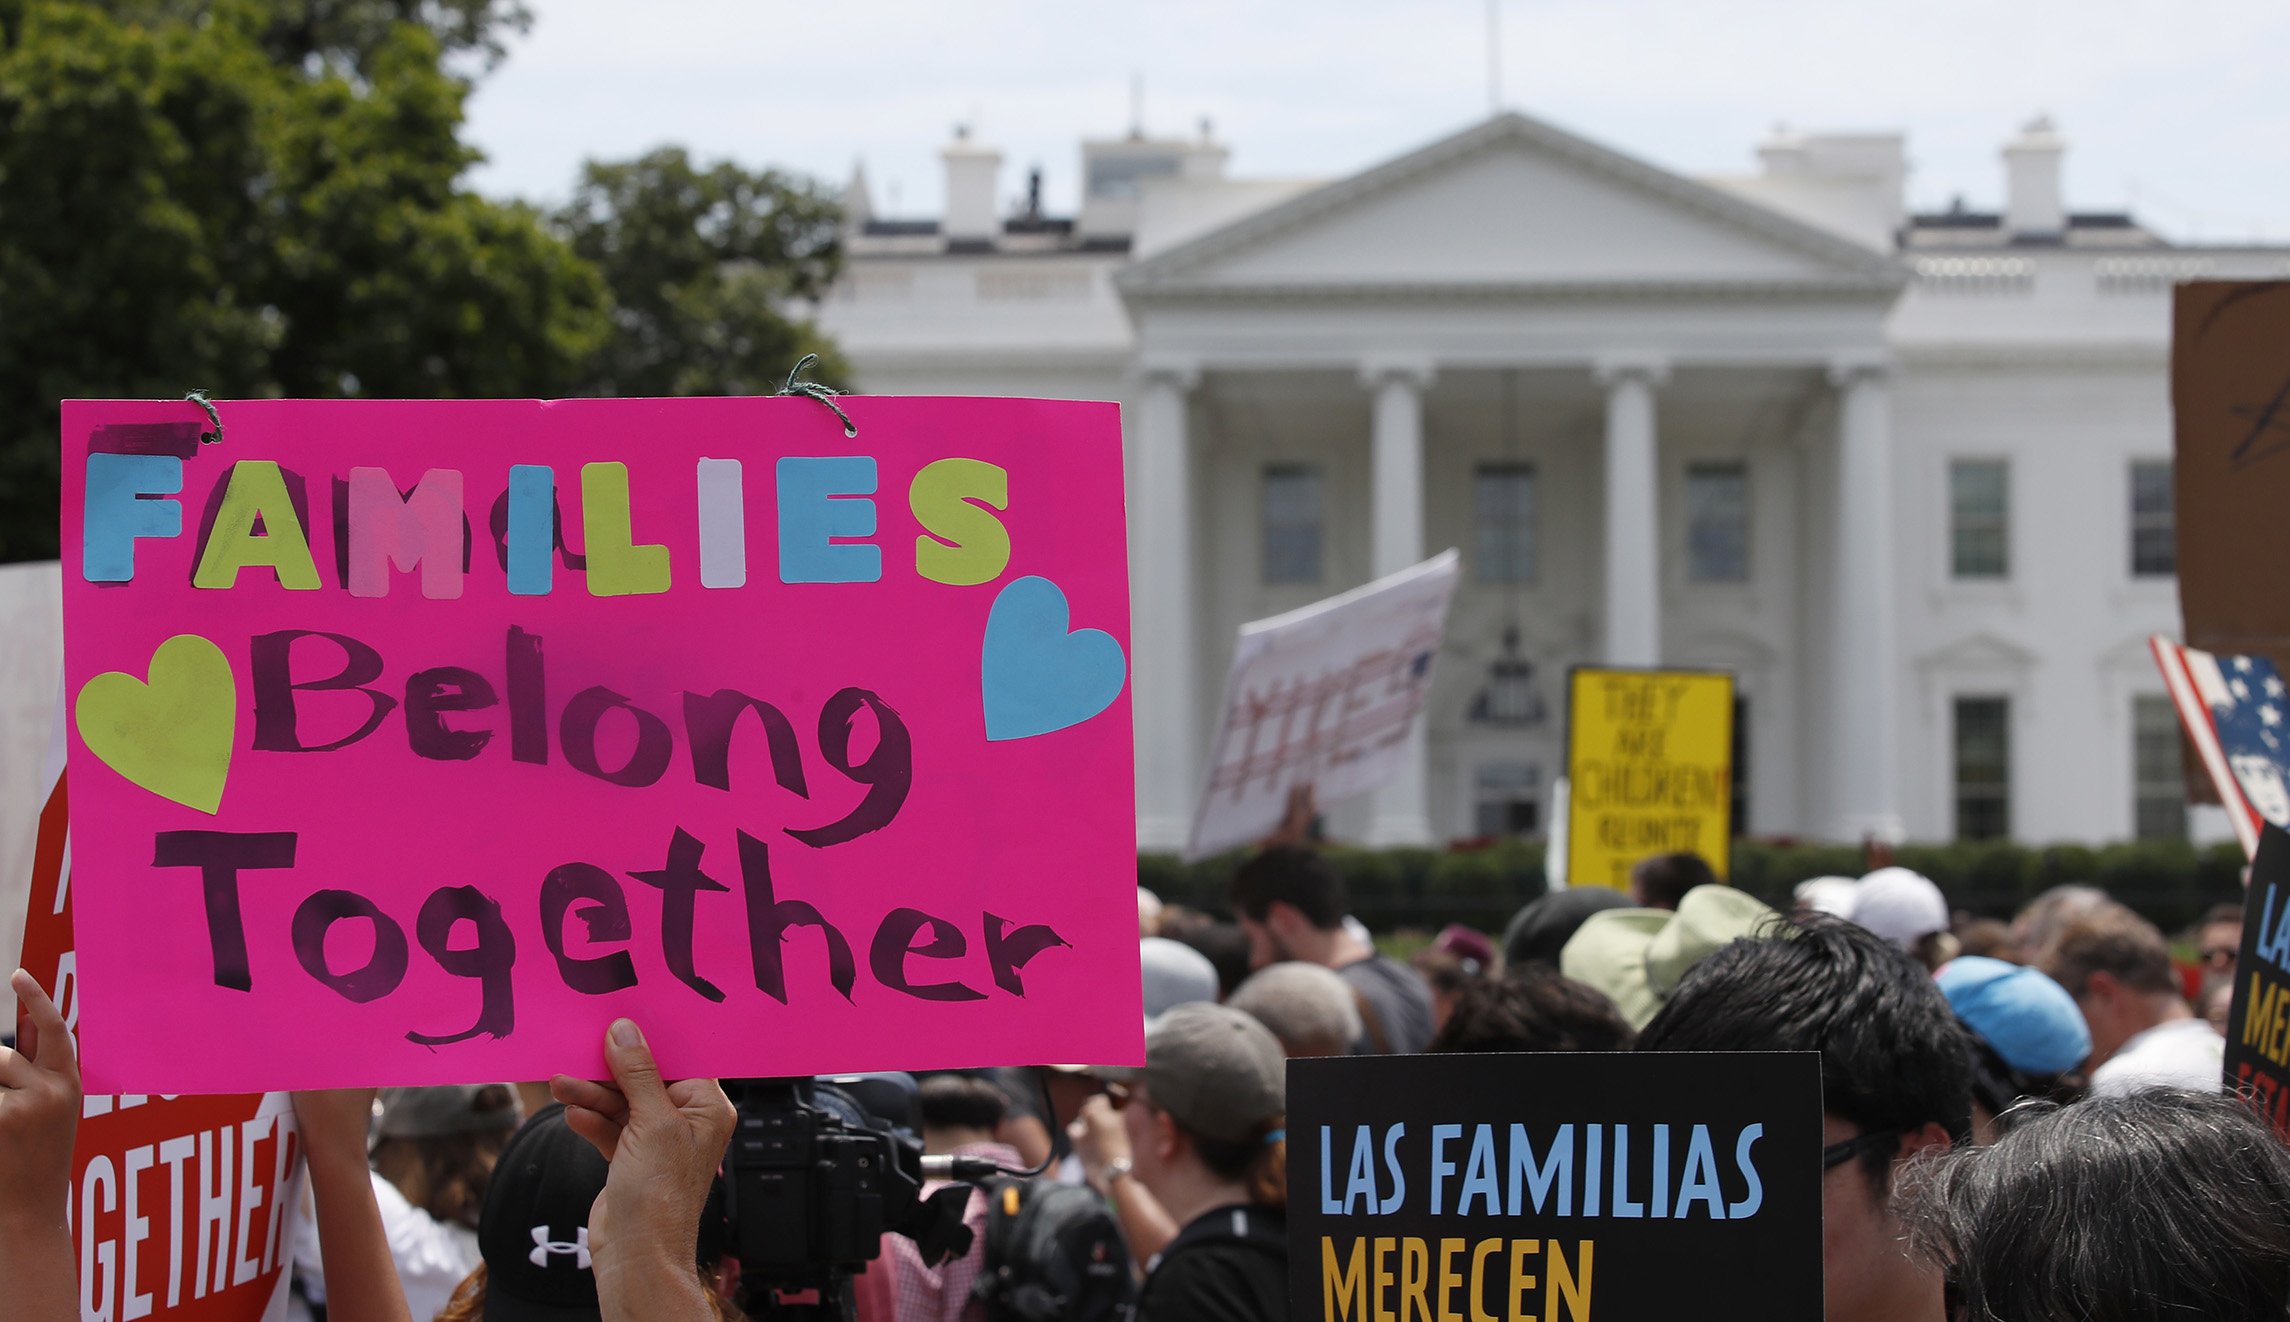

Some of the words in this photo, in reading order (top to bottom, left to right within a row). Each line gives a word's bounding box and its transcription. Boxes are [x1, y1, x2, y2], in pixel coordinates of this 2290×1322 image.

[82, 452, 1012, 600] FAMILIES
[250, 624, 913, 849] Belong
[150, 824, 1073, 1053] Together
[2256, 882, 2290, 974] LA
[66, 1111, 299, 1322] GETHER
[1320, 1122, 1406, 1216] LAS
[1430, 1122, 1764, 1220] FAMILIAS
[1321, 1236, 1594, 1322] MERECEN
